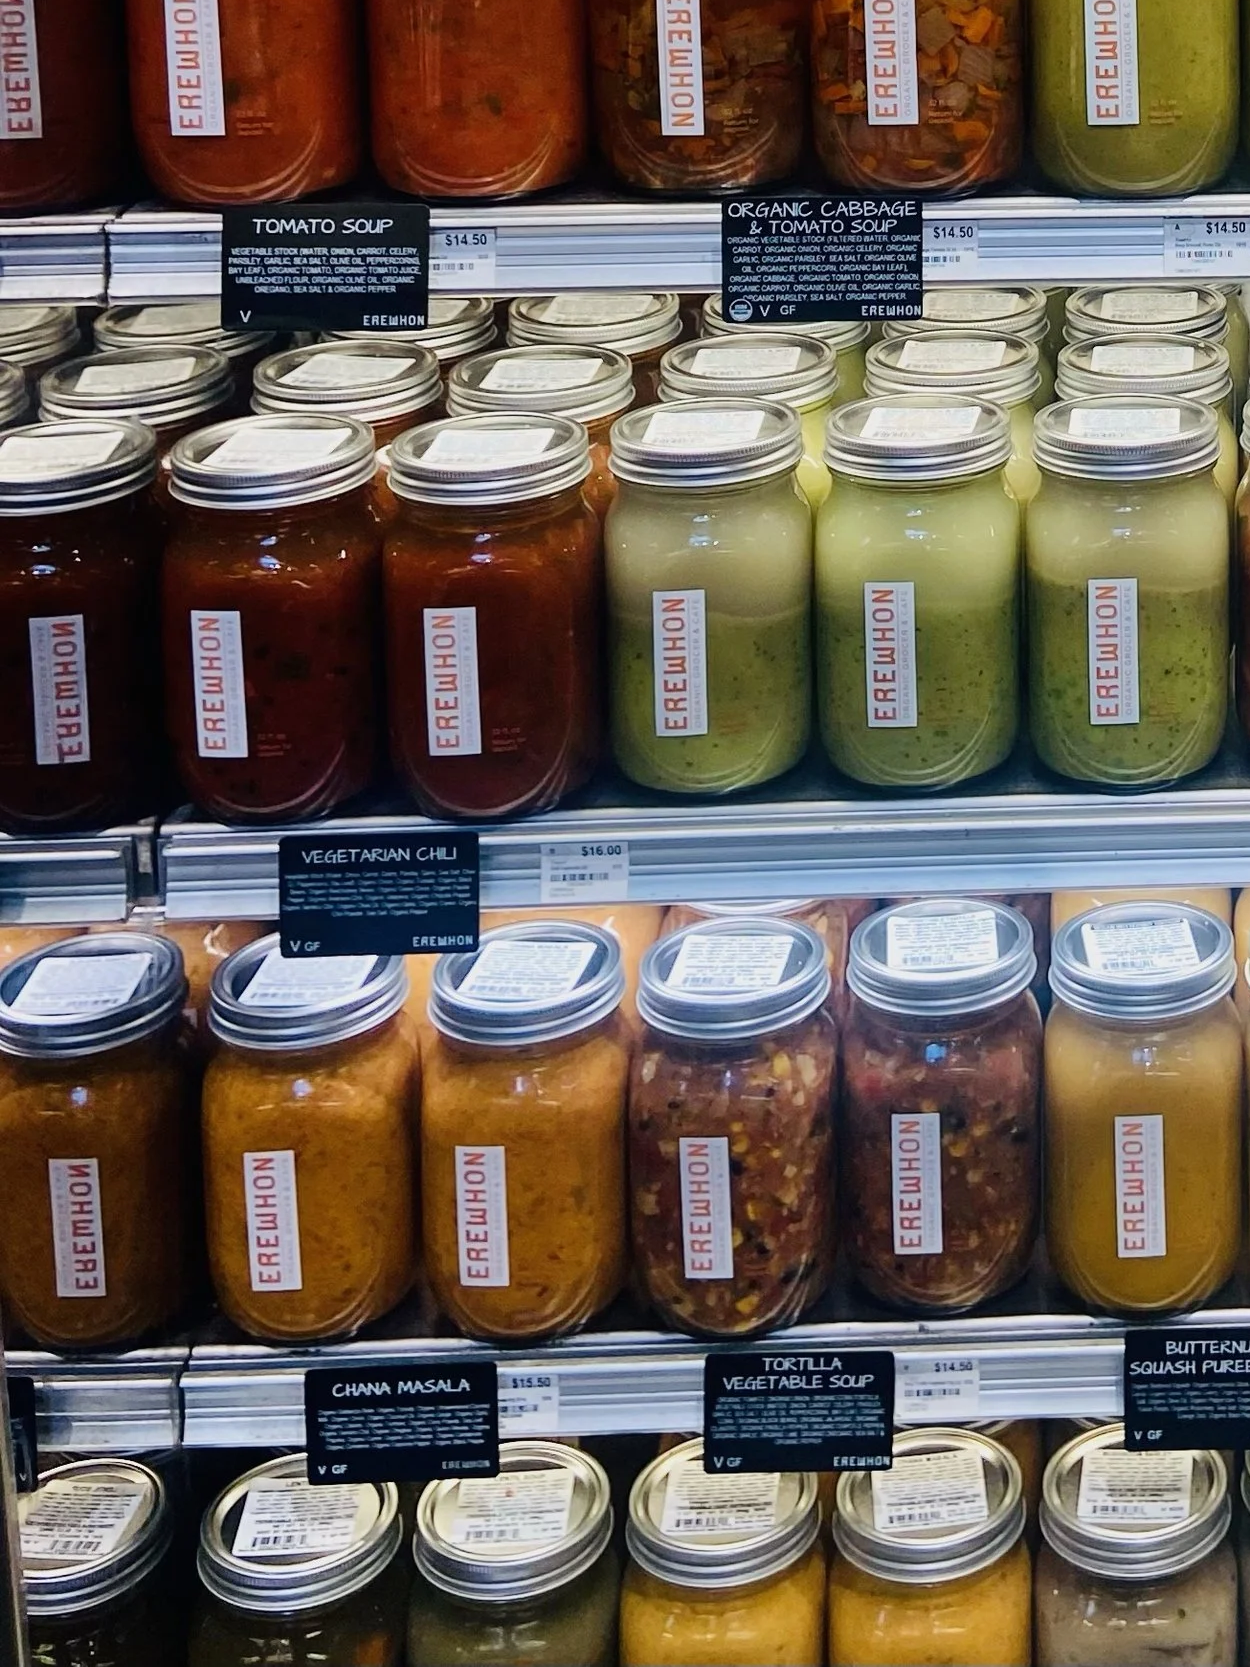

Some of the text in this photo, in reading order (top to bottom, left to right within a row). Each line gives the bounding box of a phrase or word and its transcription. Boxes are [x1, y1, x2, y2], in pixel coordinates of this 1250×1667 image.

[727, 200, 918, 218] ORGANIC CABBAGE
[252, 218, 394, 235] TOMATO SOUP
[749, 219, 898, 235] & TOMATO SOUP
[933, 225, 974, 240] $14.50
[1206, 221, 1246, 235] $14.50
[445, 233, 488, 247] $14.50
[861, 304, 922, 316] EREWHON
[363, 314, 425, 326] EREWHON
[1095, 584, 1118, 717] EREWHON
[663, 598, 686, 728] EREWHON
[199, 616, 225, 751] EREWHON
[301, 846, 457, 864] VEGETARIAN CHILI
[578, 841, 622, 857] $16.00
[289, 940, 321, 953] V GF
[412, 934, 474, 948] EREWHON
[1122, 1122, 1145, 1250] EREWHON
[687, 1142, 712, 1272] EREWHON
[249, 1154, 280, 1288] EREWHON
[762, 1357, 842, 1372] TORTILLA
[1129, 1360, 1197, 1375] SQUASH
[331, 1378, 471, 1398] CHANA MASALA
[722, 1374, 875, 1391] VEGETABLE SOUP
[833, 1455, 891, 1467] EREWHON
